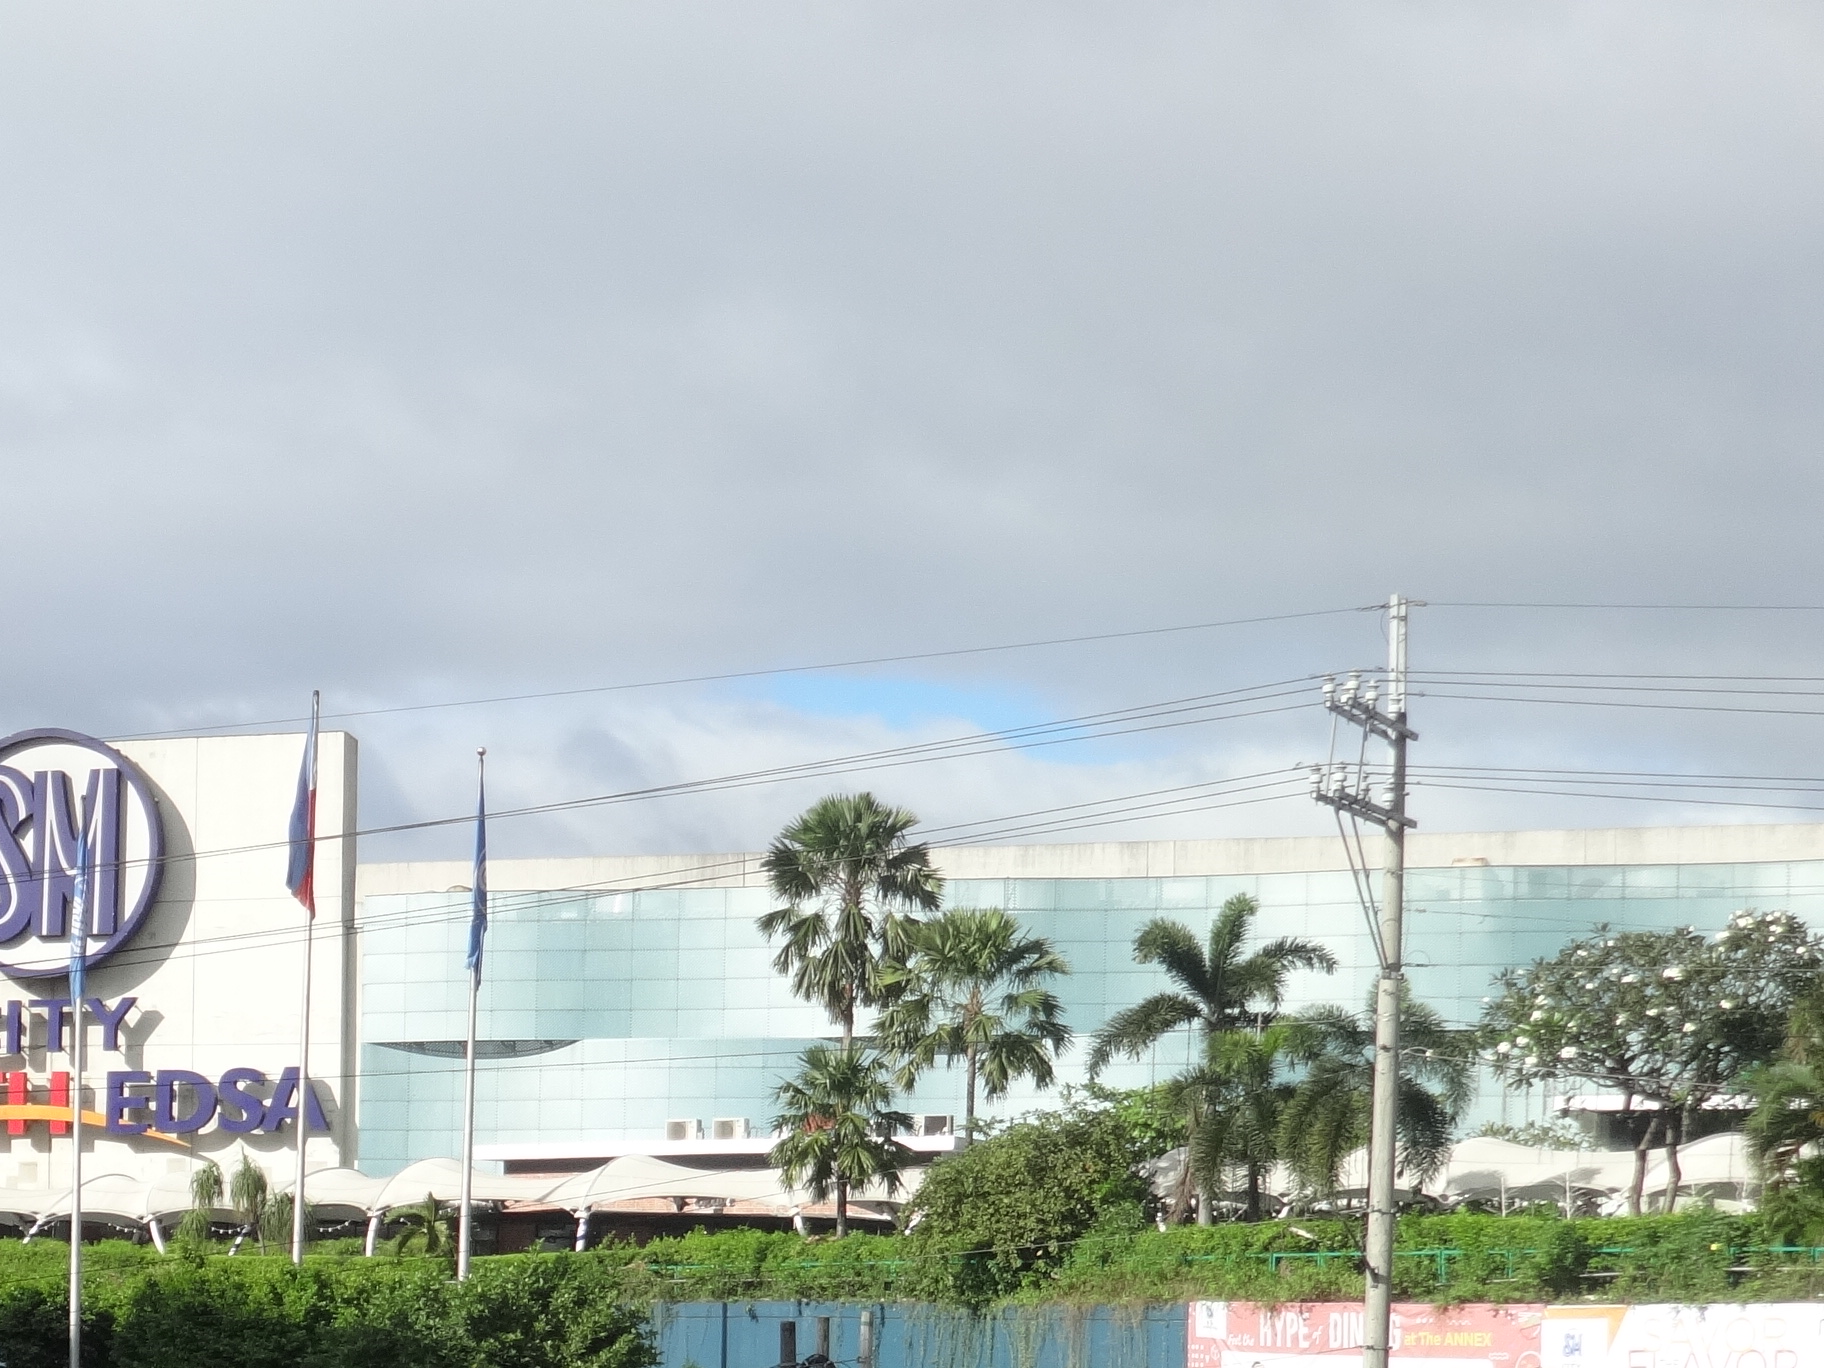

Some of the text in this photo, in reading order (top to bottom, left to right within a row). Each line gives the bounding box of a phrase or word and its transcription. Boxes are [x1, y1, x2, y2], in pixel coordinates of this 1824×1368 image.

[105, 1067, 331, 1135] EDSA
[1259, 1312, 1311, 1349] HYPE
[1312, 1325, 1324, 1345] of
[1328, 1312, 1402, 1351] DING
[1404, 1333, 1417, 1346] at
[1419, 1332, 1441, 1346] The
[1443, 1331, 1492, 1347] ANNEX
